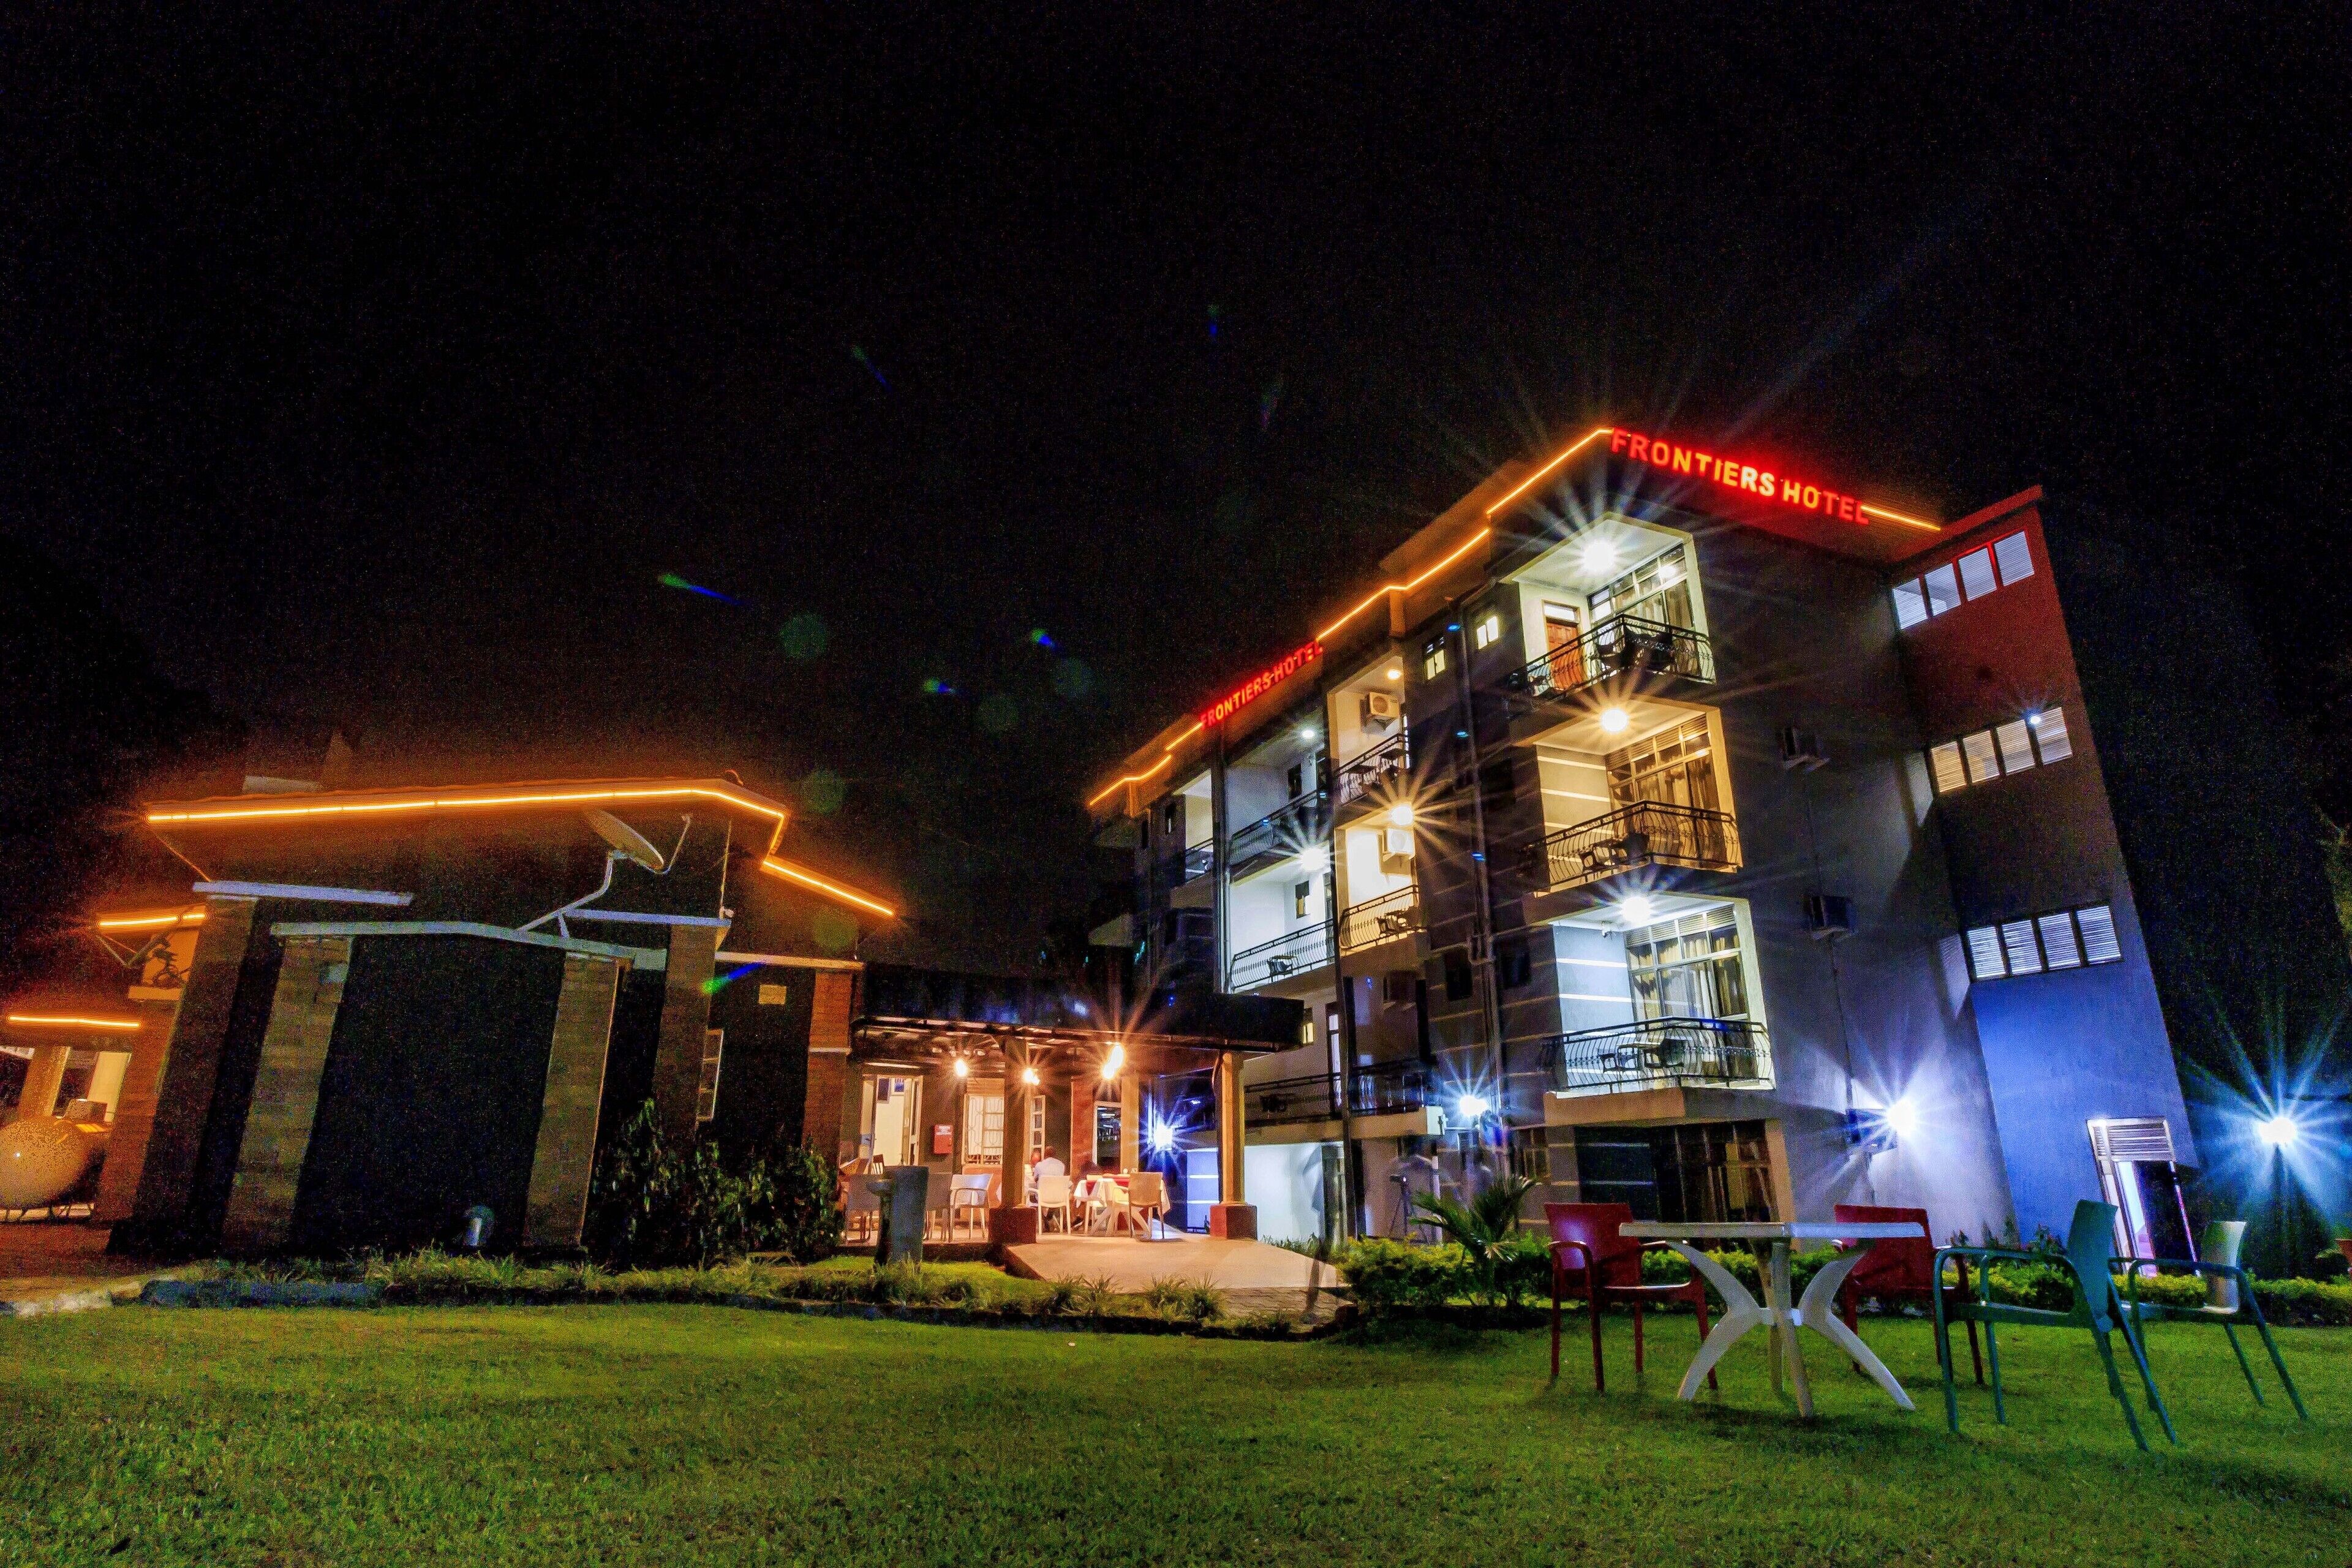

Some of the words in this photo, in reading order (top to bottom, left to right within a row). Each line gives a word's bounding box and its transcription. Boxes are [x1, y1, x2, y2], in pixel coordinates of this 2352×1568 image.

[1612, 429, 1775, 497] FRONTIERS
[1784, 480, 1869, 524] HOTEL
[1200, 673, 1272, 730] FRONTIERS
[1273, 642, 1323, 682] HOTEL
